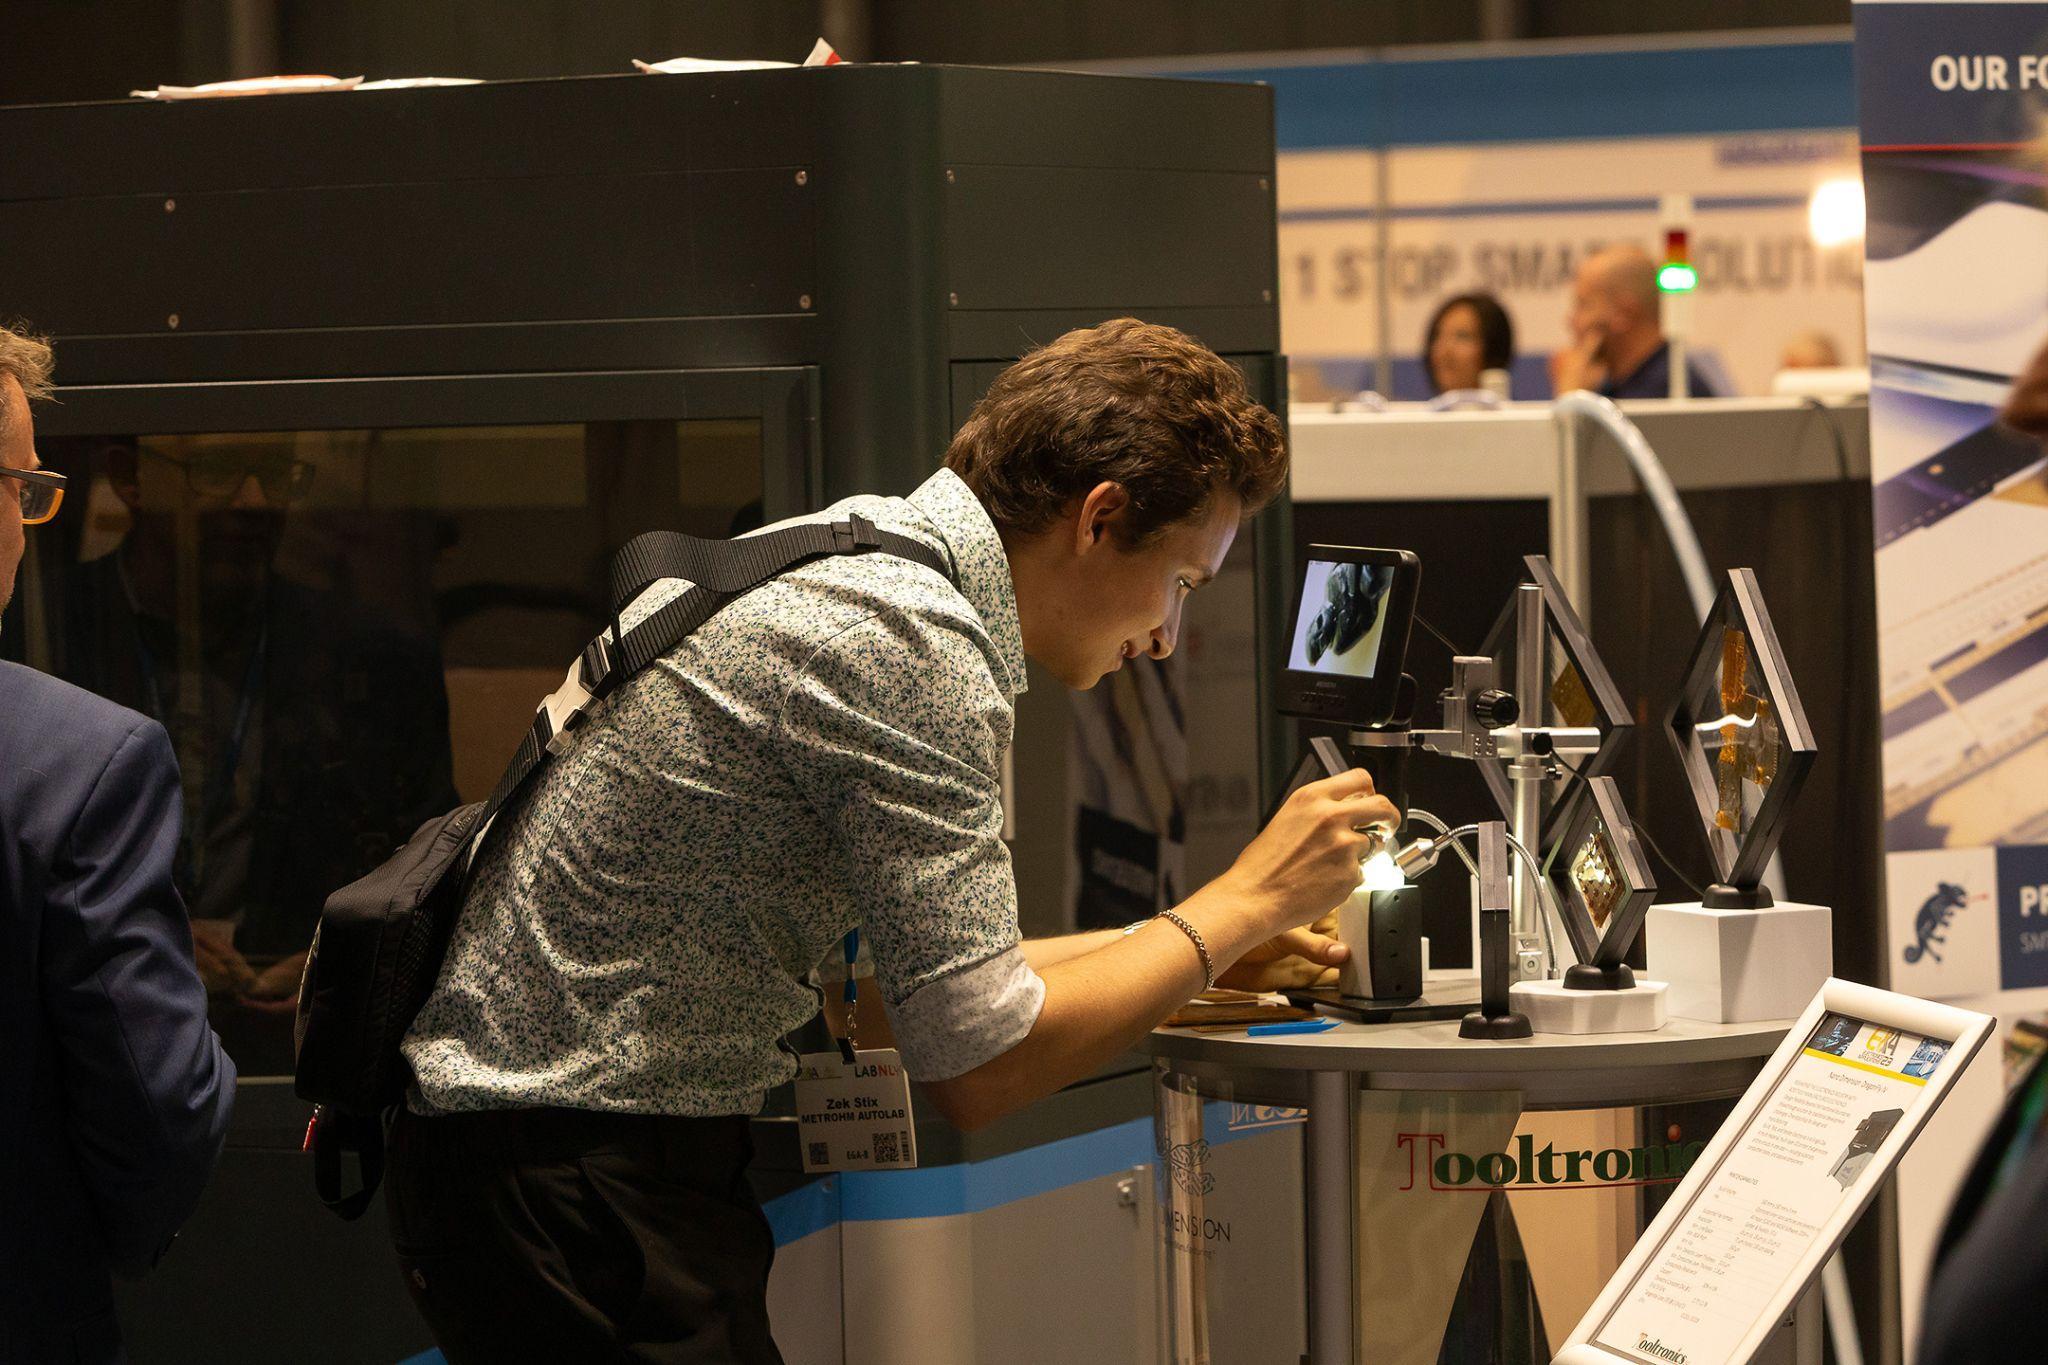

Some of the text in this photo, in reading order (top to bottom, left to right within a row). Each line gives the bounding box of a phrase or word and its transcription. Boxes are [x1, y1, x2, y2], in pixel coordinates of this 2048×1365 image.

[1931, 54, 2009, 92] OUR
[801, 1109, 905, 1124] METROHM AUTOLAB
[1397, 1123, 1706, 1190] Tooltronic
[1632, 1332, 1687, 1365] Tooltronics
